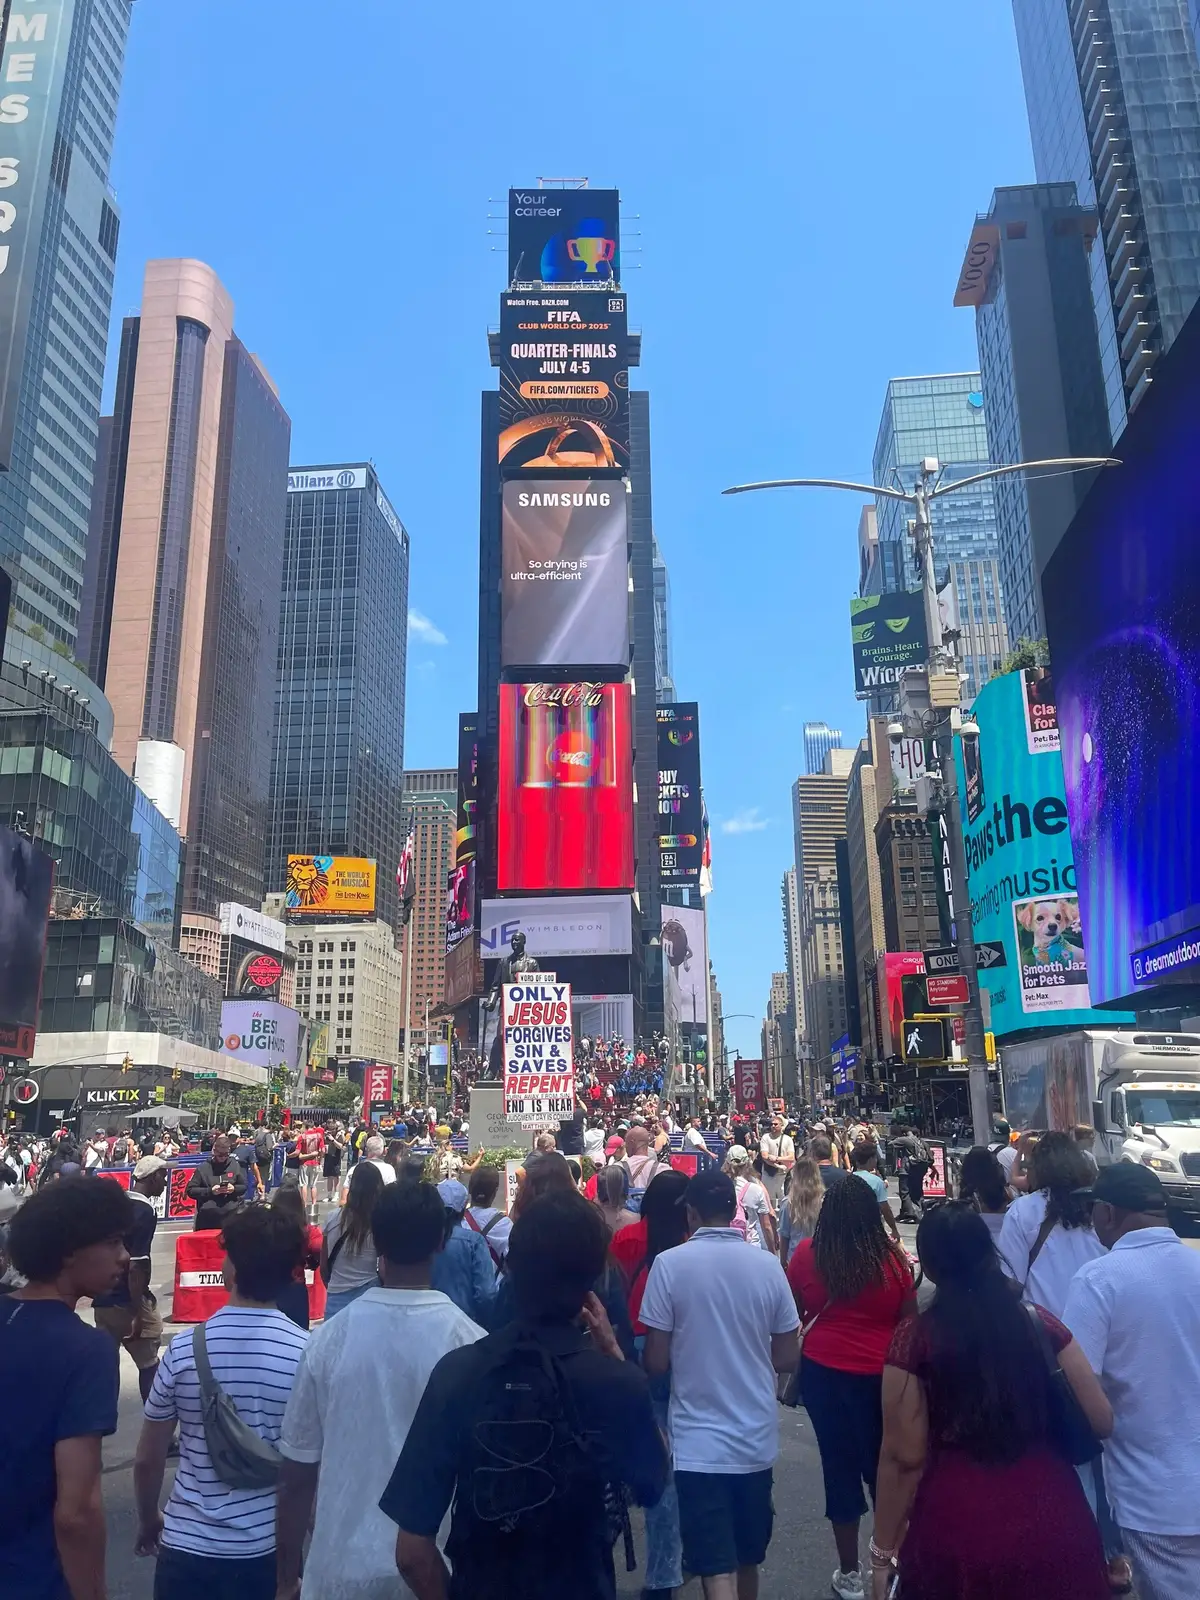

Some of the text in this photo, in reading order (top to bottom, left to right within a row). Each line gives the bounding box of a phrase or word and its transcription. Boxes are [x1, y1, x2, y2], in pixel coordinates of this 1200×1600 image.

[0, 13, 48, 124] MES
[515, 193, 547, 205] Your
[515, 206, 562, 217] career
[547, 311, 582, 322] FIFA
[511, 343, 617, 359] QUARTER-FINALS
[540, 360, 591, 374] JULY 4-5
[529, 385, 600, 395] FIFA.COM/TICKETS
[287, 474, 334, 489] Allianz
[518, 493, 611, 507] SAMSUNG
[528, 560, 588, 571] So drying is
[510, 571, 582, 580] ultra-efficient
[861, 641, 923, 657] Brains. Heart.
[873, 651, 913, 663] Courage.
[655, 709, 676, 717] FIFA
[1034, 718, 1056, 730] for
[1033, 735, 1048, 744] Pet:
[657, 769, 678, 784] BUY
[993, 794, 1068, 848] the
[964, 818, 994, 882] Paws
[335, 870, 370, 879] THE WORLD'S
[1000, 858, 1077, 900] music
[340, 879, 370, 888] MUSICAL
[243, 919, 261, 930] HYATT
[527, 924, 603, 933] WIMBLEDON
[936, 950, 993, 967] ONE AY
[1023, 961, 1064, 976] Smooth
[520, 974, 535, 982] WORD
[535, 974, 542, 982] OF
[936, 978, 959, 986] STANDING
[1024, 975, 1066, 988] for Pets
[509, 986, 566, 1002] ONLY
[929, 985, 949, 993] Anytime
[252, 1010, 263, 1018] the
[508, 1002, 568, 1026] JESUS
[505, 1026, 572, 1044] FORGIVES
[514, 1044, 560, 1058] SIN &
[508, 1058, 568, 1074] SAVES
[371, 1068, 389, 1101] tkts
[506, 1074, 573, 1094] REPENT
[741, 1063, 759, 1099] tkts
[87, 1089, 140, 1103] KLIKTIX
[506, 1098, 572, 1113] END IS NEAR
[198, 1274, 225, 1286] TIM
